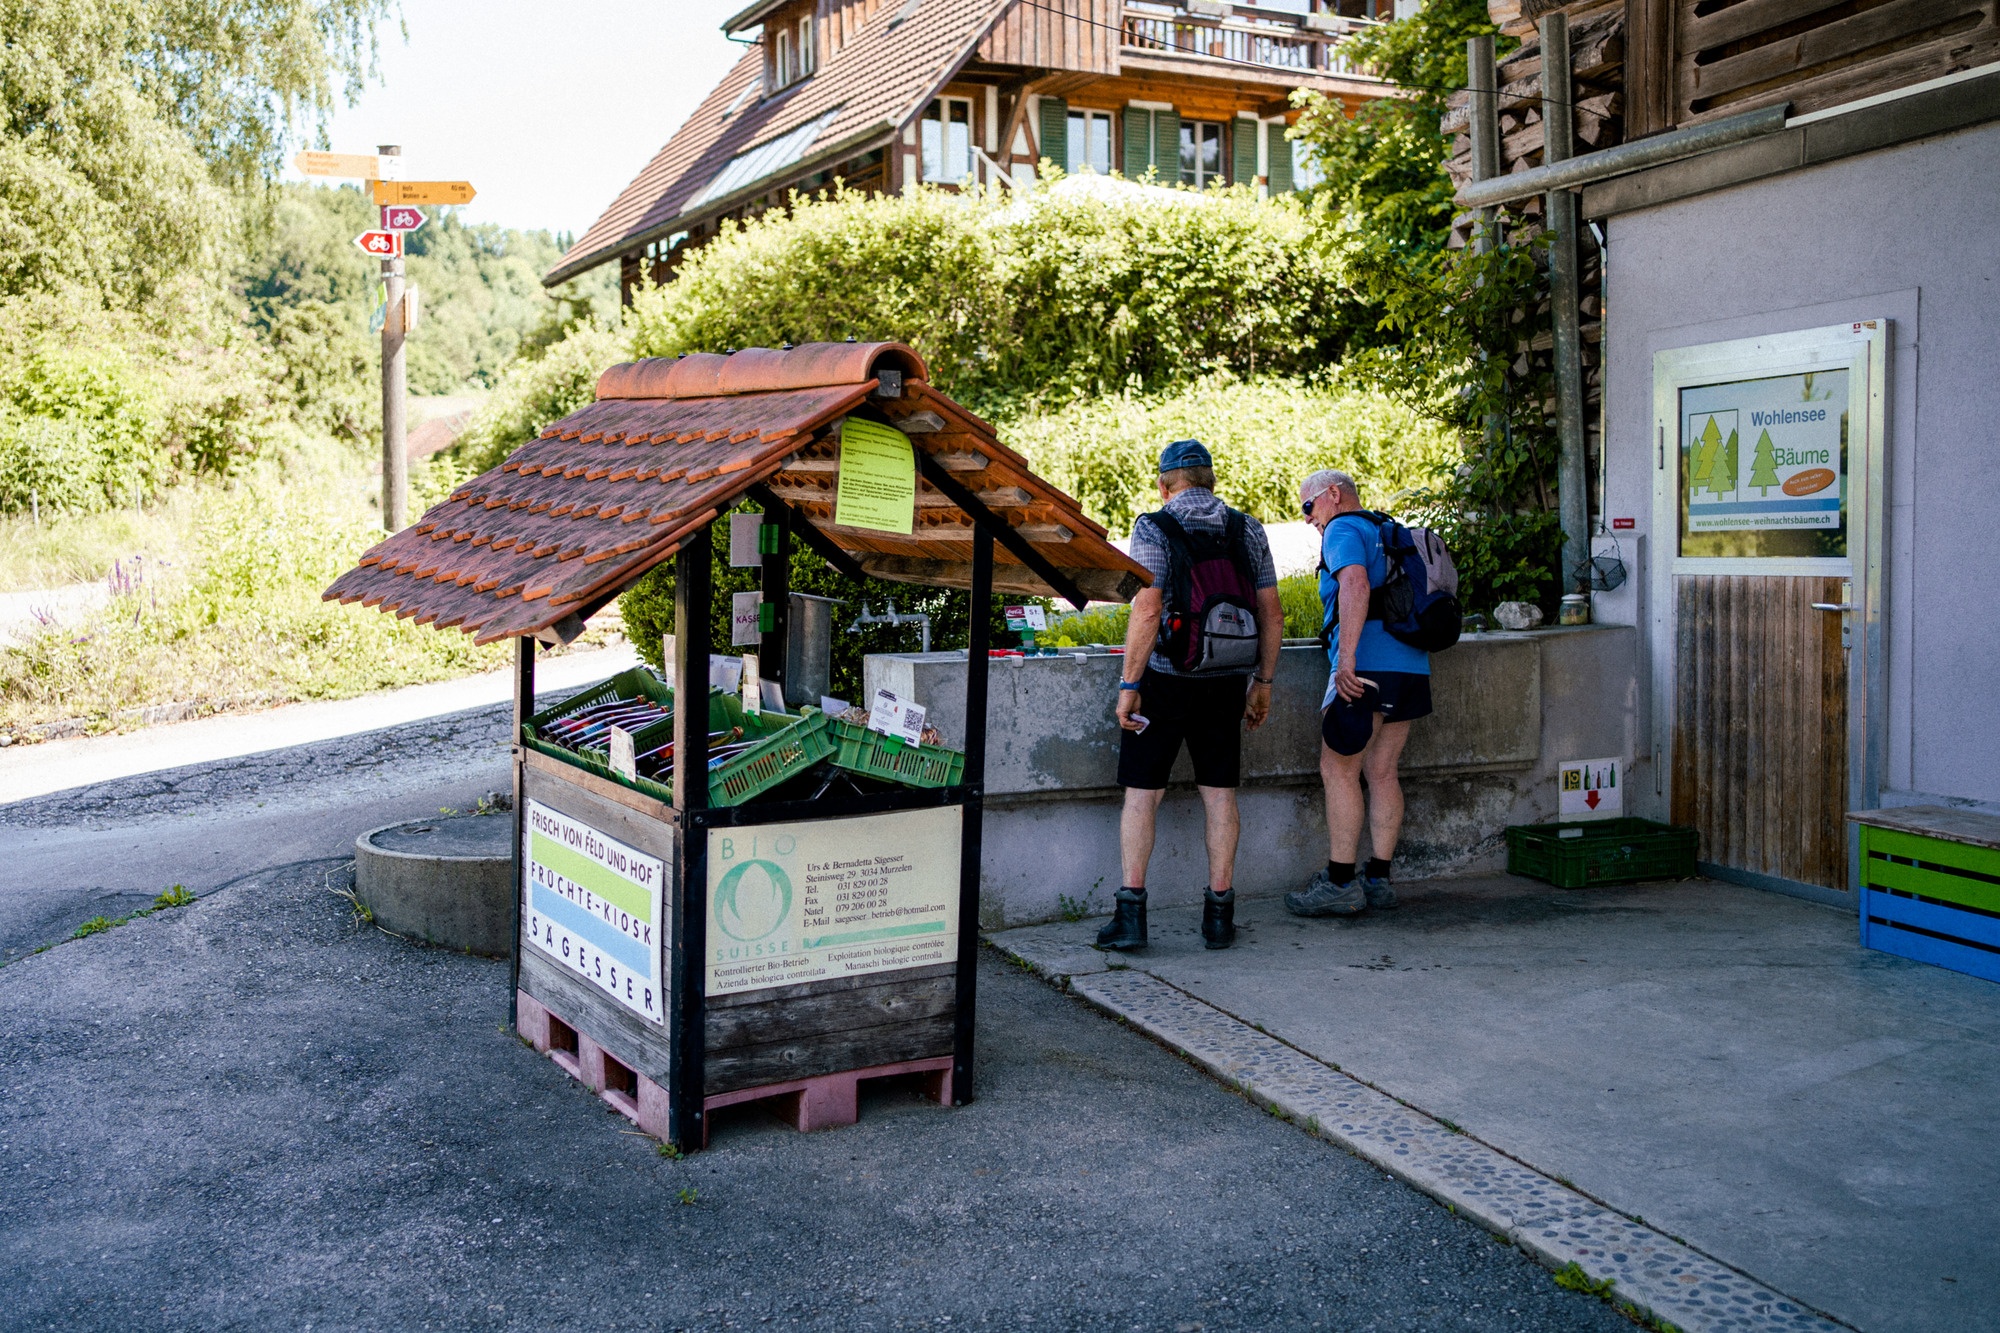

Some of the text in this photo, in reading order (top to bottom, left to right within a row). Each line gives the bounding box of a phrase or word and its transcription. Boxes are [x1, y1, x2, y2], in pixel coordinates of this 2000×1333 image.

[1751, 408, 1826, 426] Wohlensee
[1775, 448, 1830, 466] Bäume
[1696, 515, 1831, 528] www.wohlensee-weihnachtsbäume.ch
[532, 810, 652, 885] FRISCH VON FELD UND HOF
[722, 834, 796, 860] BIO
[807, 863, 820, 872] Urs
[822, 862, 830, 870] &
[832, 858, 872, 870] Bernadetta
[846, 870, 856, 879] 29
[860, 869, 878, 878] 3034
[880, 864, 912, 875] Murzelen
[806, 877, 888, 894] Tel. 031 829 00 28
[804, 888, 888, 906] Fax 031 829 00 50
[804, 899, 888, 916] Natel 079 206 00 28
[803, 917, 830, 928] E-Mail
[716, 940, 788, 962] SUISSE
[828, 948, 872, 963] Exploitation
[874, 944, 910, 956] biologique
[532, 916, 653, 1012] SÄGESSER
[714, 958, 810, 978] Kontrollierter Bio-Betrieb
[844, 960, 880, 972] Manaschi
[882, 956, 910, 968] biologic
[716, 967, 826, 990] Azienda biologica controllata
